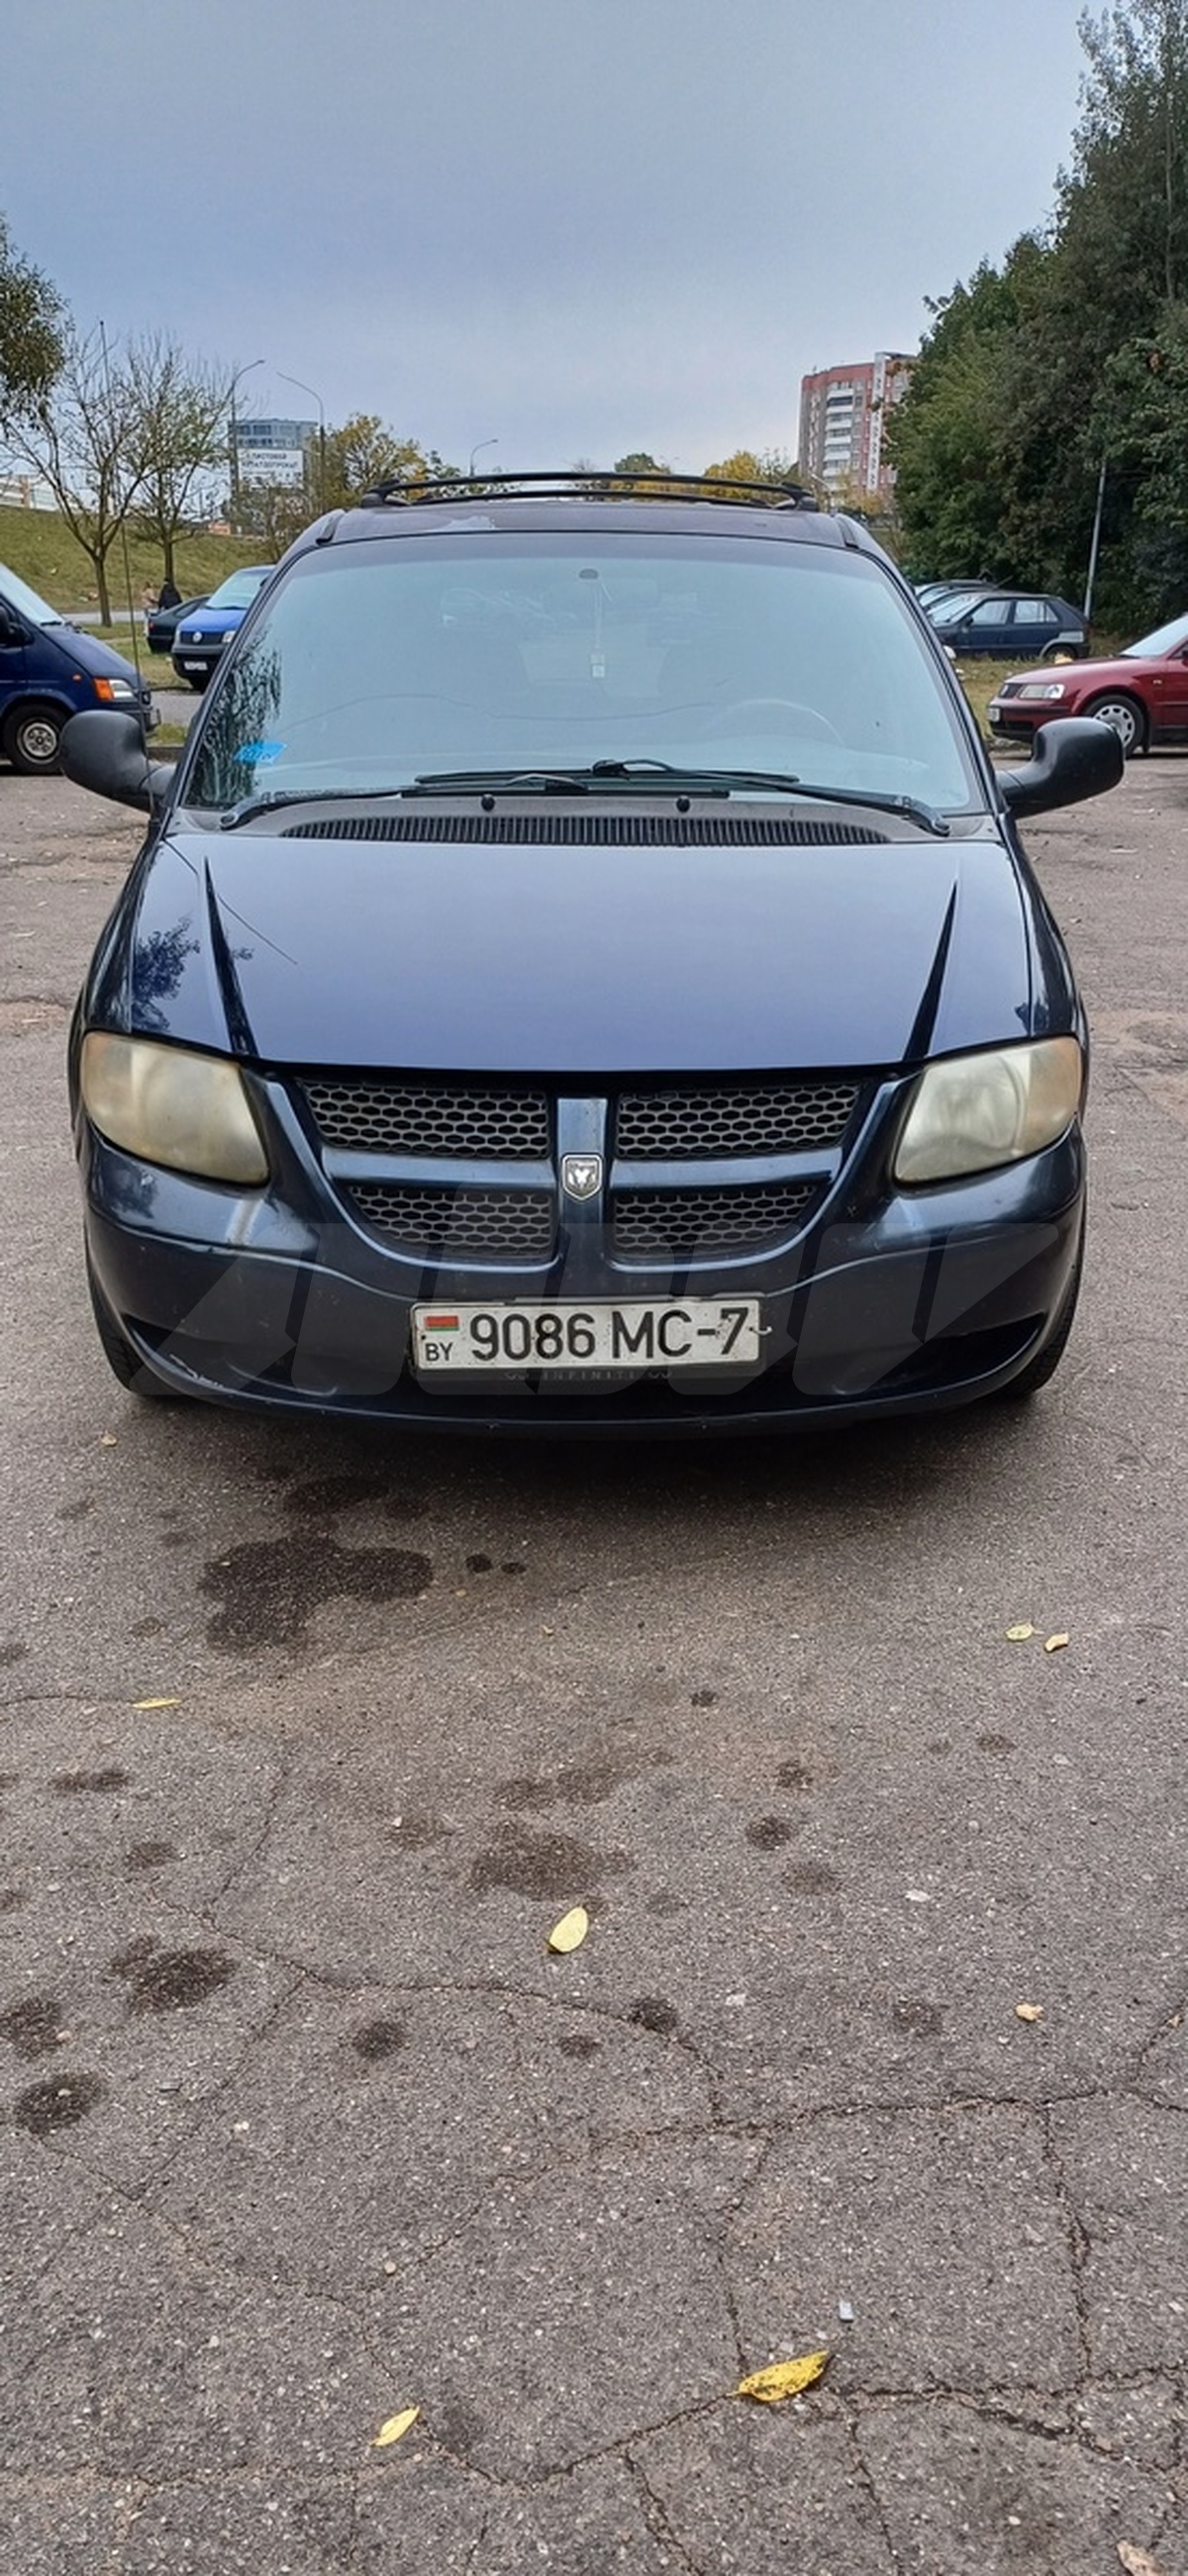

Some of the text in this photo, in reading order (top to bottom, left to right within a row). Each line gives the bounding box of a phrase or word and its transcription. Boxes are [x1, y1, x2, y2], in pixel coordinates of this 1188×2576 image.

[425, 1343, 453, 1361] BY
[470, 1307, 749, 1361] 9086 MC-7
